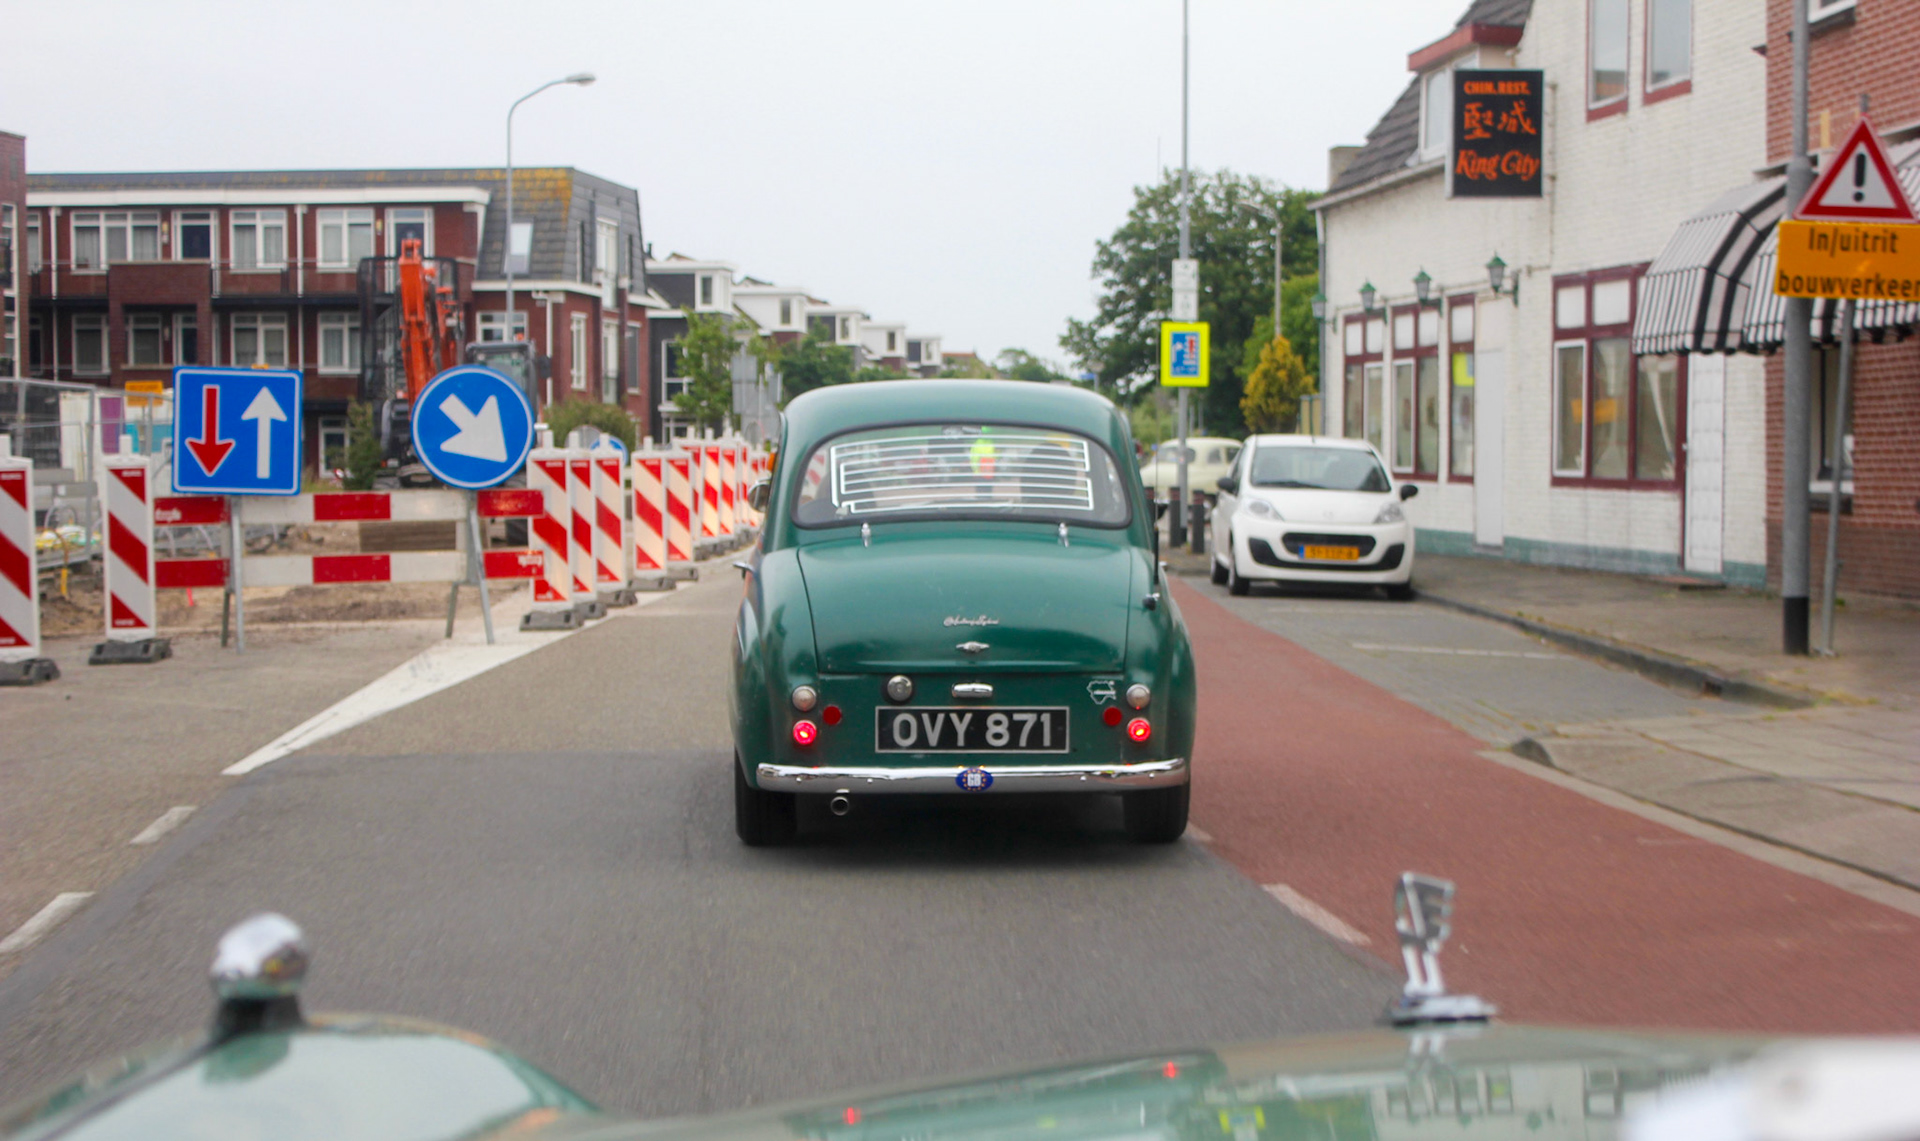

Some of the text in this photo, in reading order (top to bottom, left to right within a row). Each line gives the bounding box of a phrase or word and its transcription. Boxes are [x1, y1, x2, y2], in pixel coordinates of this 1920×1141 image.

[1456, 149, 1540, 181] King City
[1808, 227, 1898, 257] In/uitrit
[892, 712, 1051, 747] OVY 871
